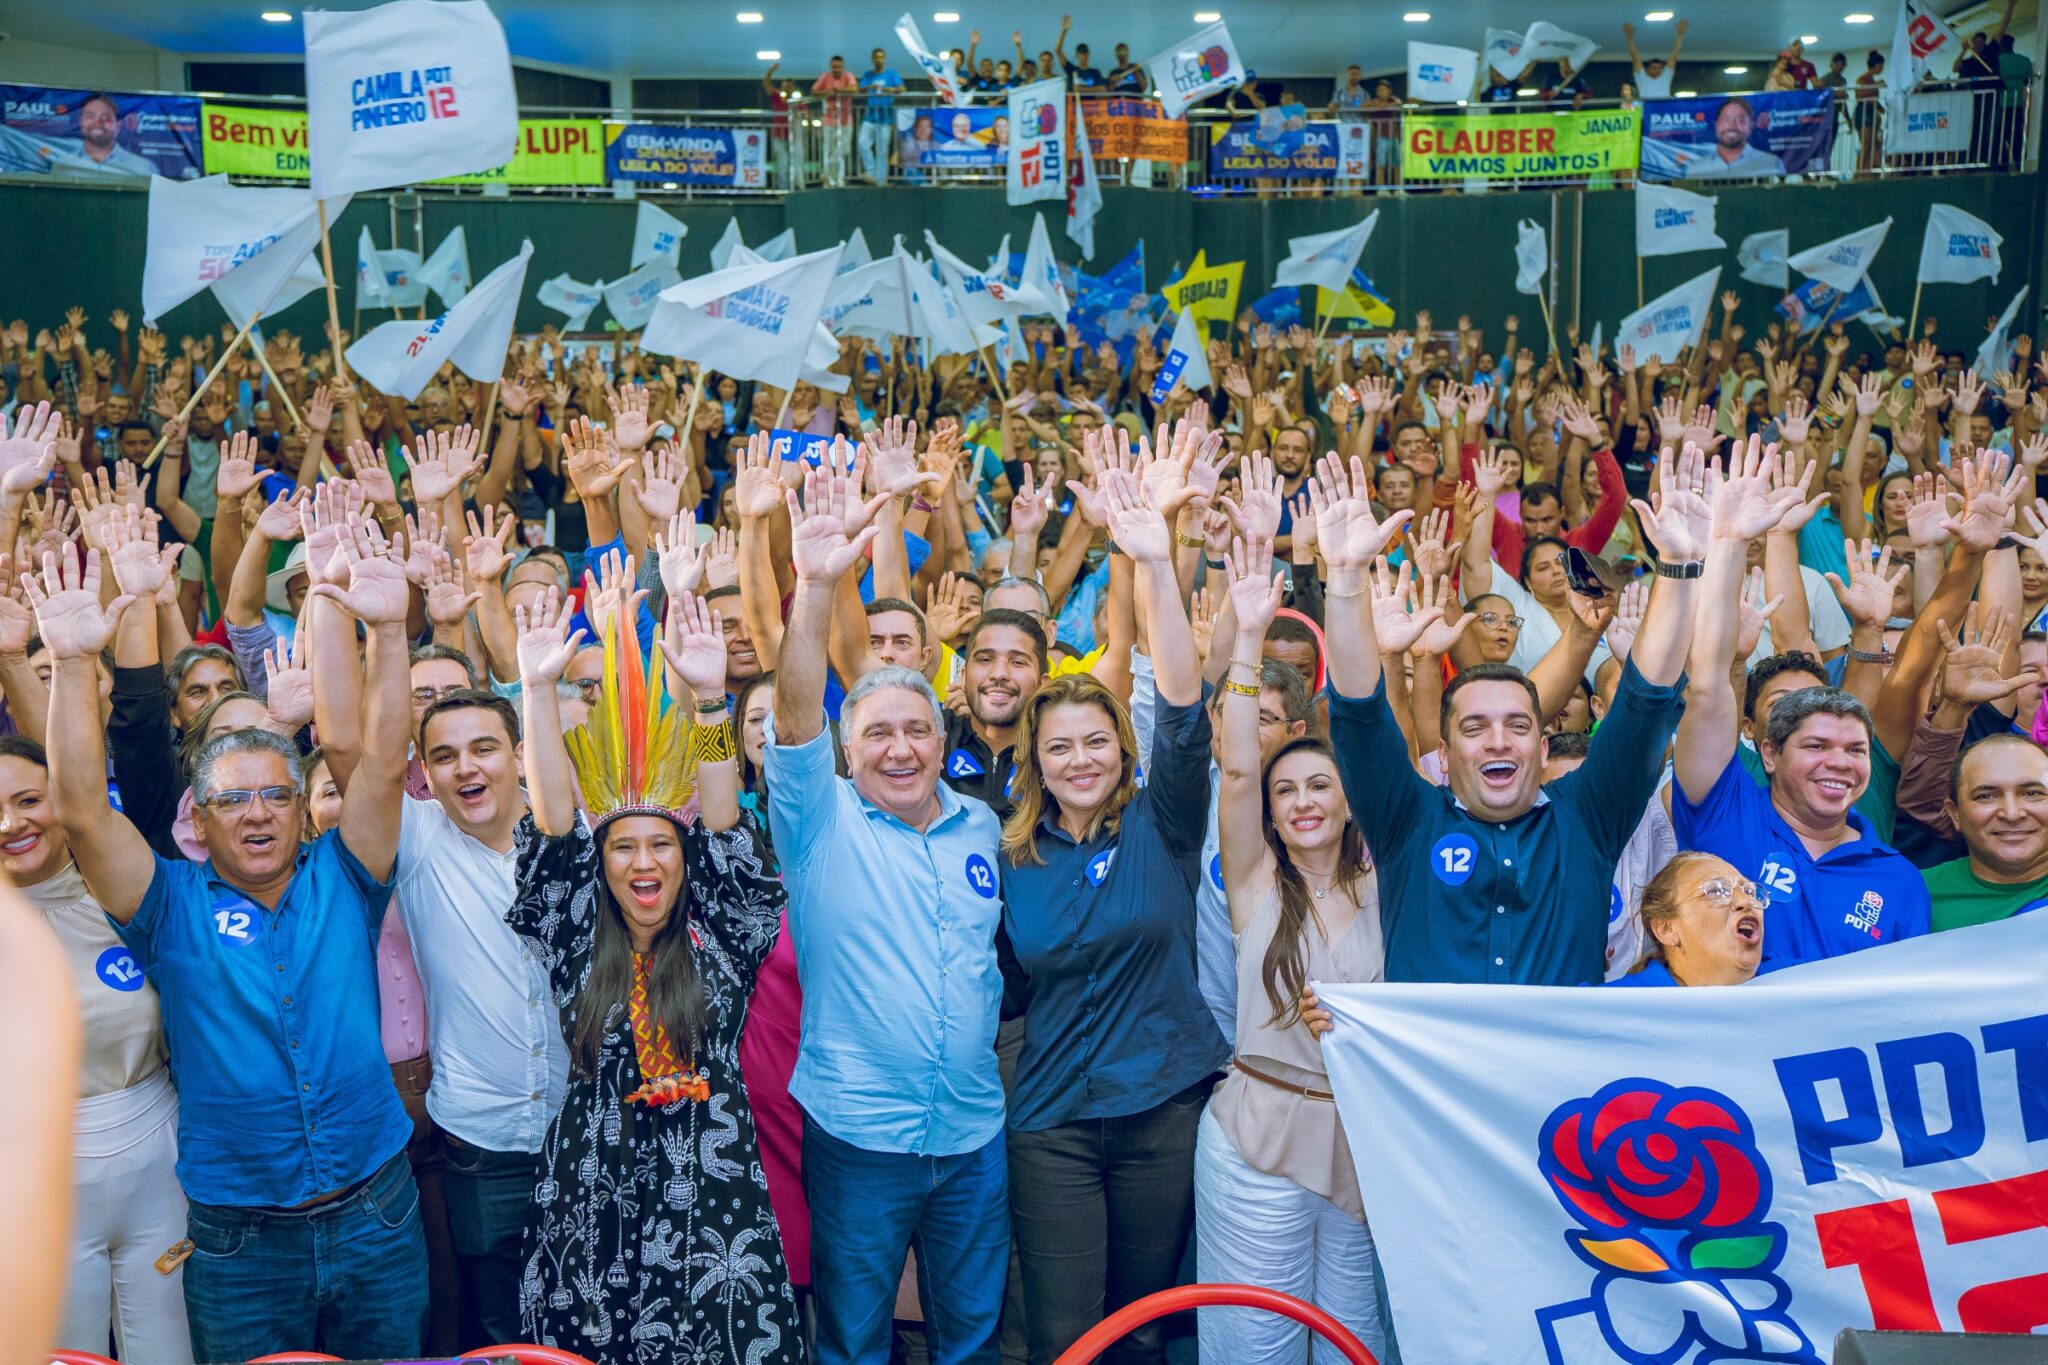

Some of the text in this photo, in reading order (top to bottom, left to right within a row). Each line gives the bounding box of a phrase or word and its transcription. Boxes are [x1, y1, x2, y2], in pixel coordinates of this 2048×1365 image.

[352, 66, 452, 106] CAMILA PDT
[352, 86, 459, 131] PINHEIRO 12
[209, 114, 274, 146] Bem
[281, 121, 309, 148] vi
[526, 127, 596, 155] LUPI.
[1411, 128, 1556, 155] GLAUBER
[276, 152, 310, 171] EDN
[619, 159, 661, 173] LEILA
[664, 161, 687, 174] DO
[1044, 140, 1060, 184] PDT
[1223, 157, 1264, 169] LEILA
[1267, 157, 1290, 169] DO
[1345, 161, 1362, 174] 12
[1429, 157, 1506, 174] VAMOS
[743, 168, 760, 183] 12
[1171, 354, 1183, 367] 12
[1162, 371, 1174, 383] 12
[109, 790, 122, 806] 1
[1439, 847, 1472, 873] 12
[971, 865, 992, 888] 12
[1764, 861, 1797, 894] 12
[214, 910, 250, 939] 12
[1844, 913, 1872, 933] PDT
[105, 956, 142, 984] 12
[1772, 1013, 2048, 1185] PDT
[1815, 1168, 2048, 1334] 12
